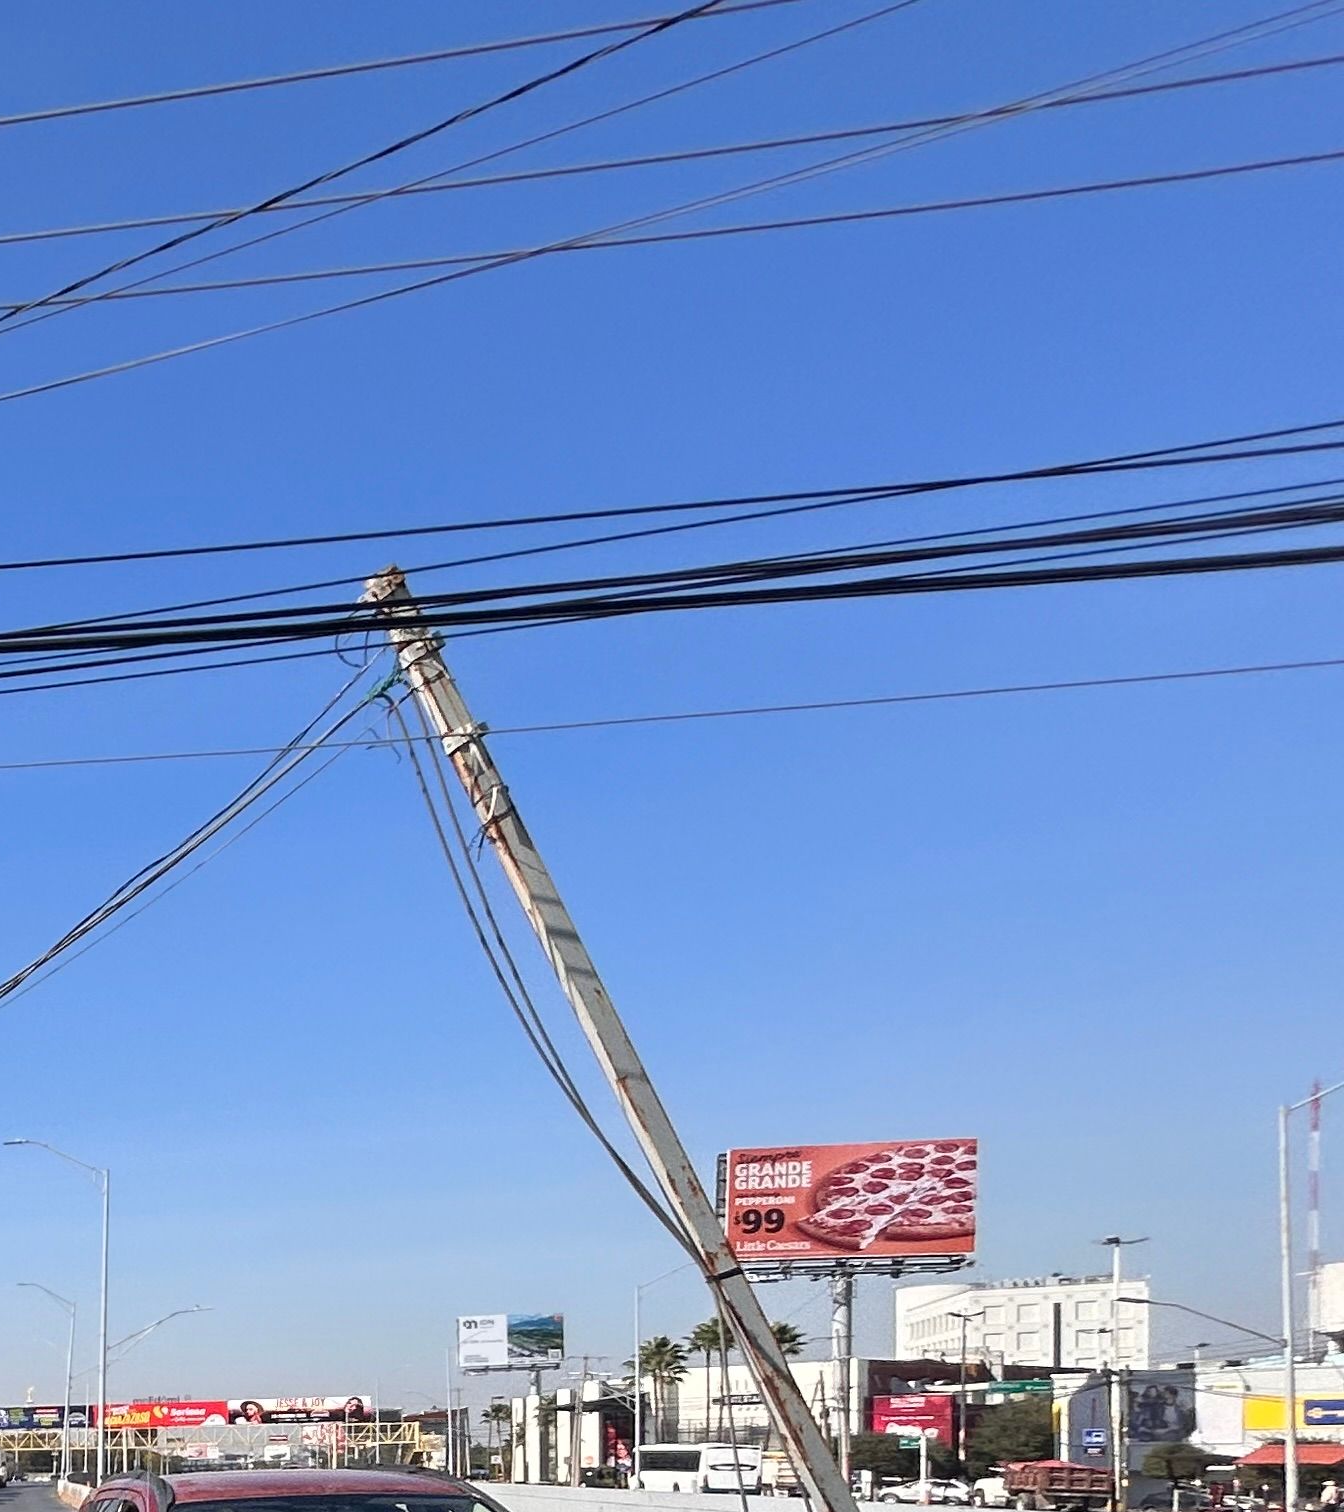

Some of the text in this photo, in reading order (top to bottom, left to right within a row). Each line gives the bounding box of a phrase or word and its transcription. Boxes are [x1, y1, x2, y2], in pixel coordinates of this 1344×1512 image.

[734, 1160, 812, 1177] GRANDE
[734, 1174, 812, 1190] GRANDE
[733, 1208, 785, 1234] $99
[736, 1240, 811, 1252] Little Caesars
